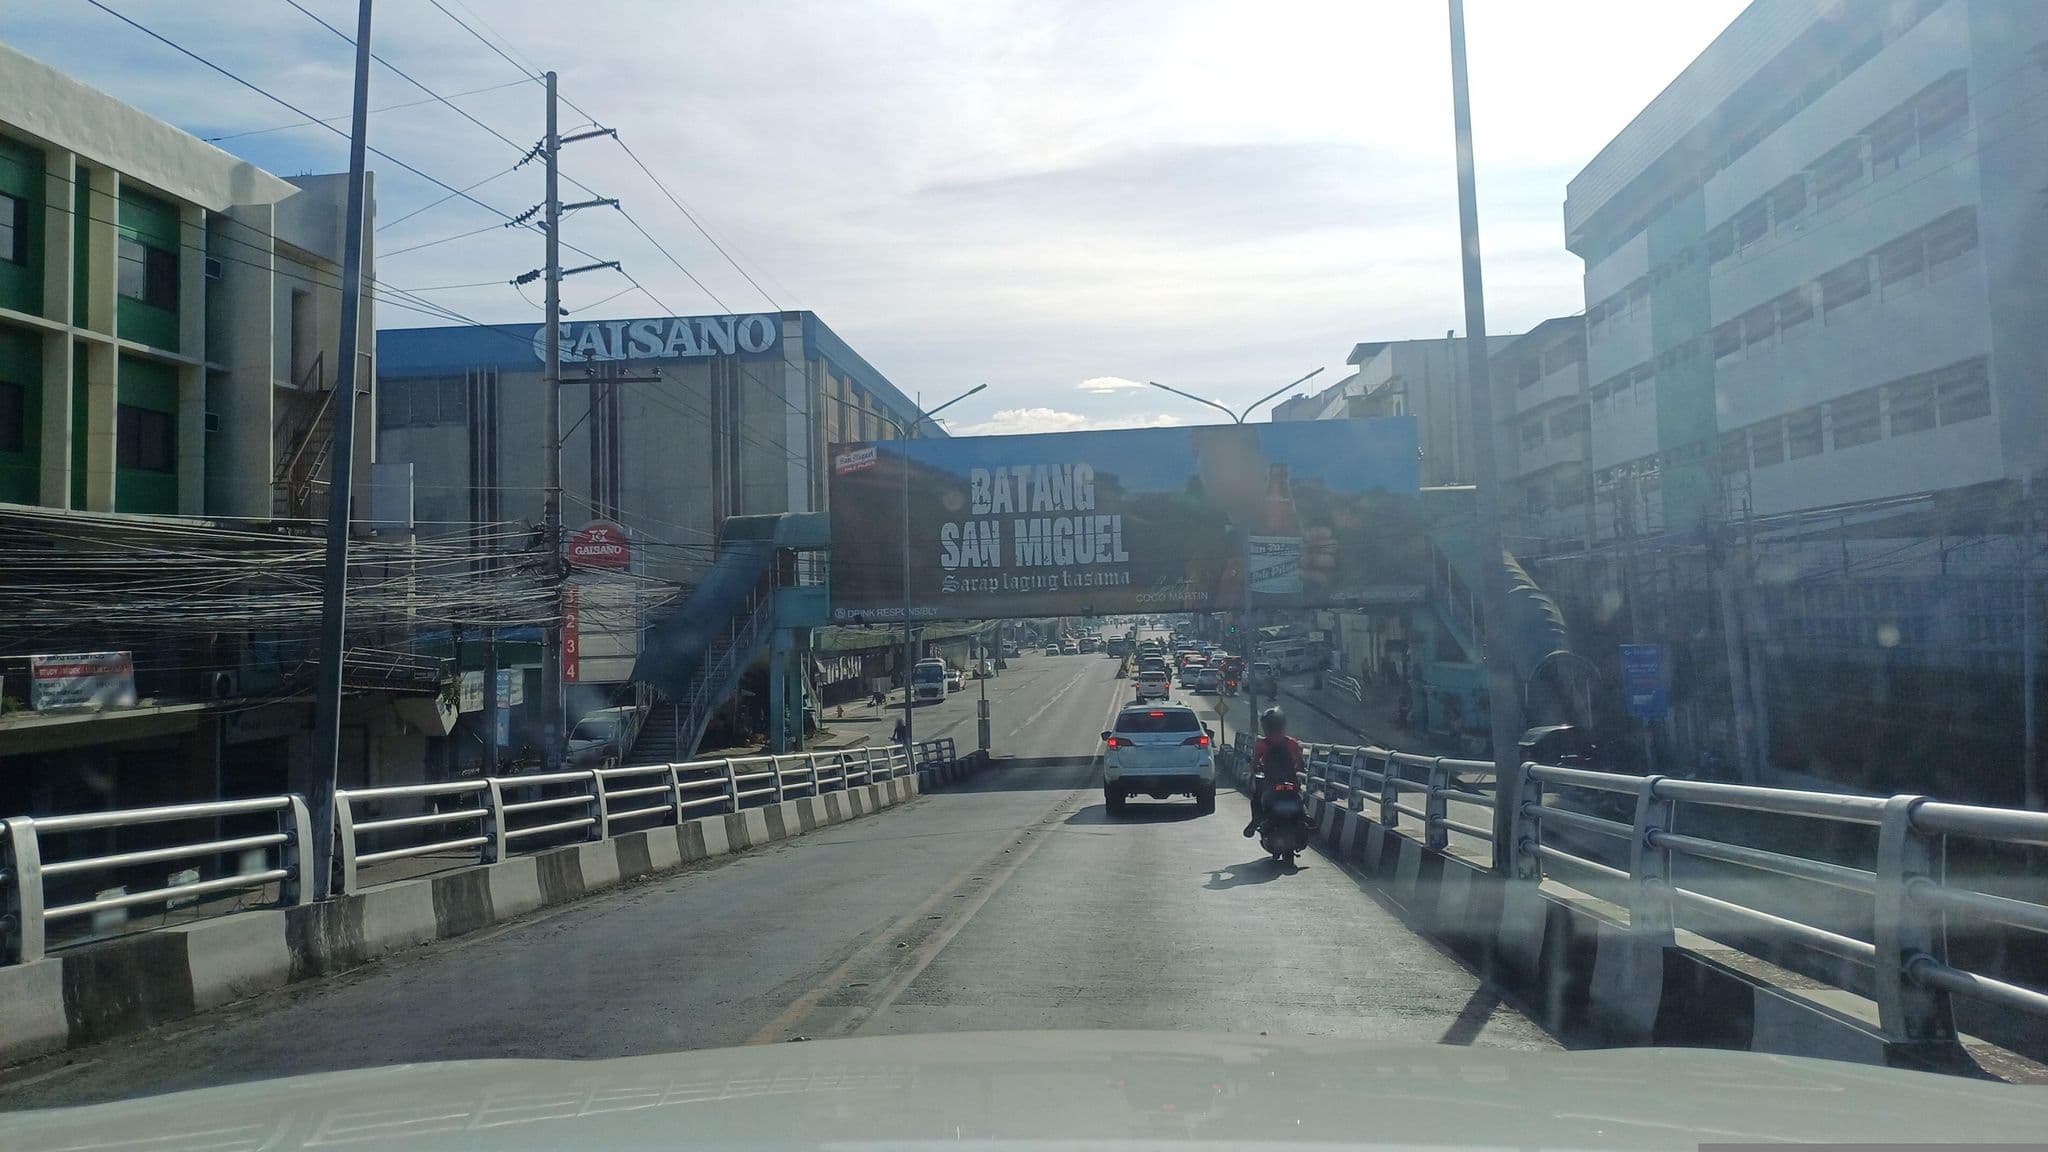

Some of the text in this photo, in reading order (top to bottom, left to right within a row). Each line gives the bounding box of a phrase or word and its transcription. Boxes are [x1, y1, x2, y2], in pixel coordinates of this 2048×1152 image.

[533, 315, 777, 363] GAISANO
[971, 463, 1095, 515] BATANG
[940, 514, 1129, 568] SAN MIGUEL
[575, 545, 622, 555] GAISANO
[941, 567, 1130, 593] Sarap laging kasama
[1136, 591, 1208, 602] COCO MARTIN
[847, 608, 876, 618] DRINK
[566, 614, 575, 628] 2
[567, 643, 575, 654] 3
[566, 664, 576, 678] 4
